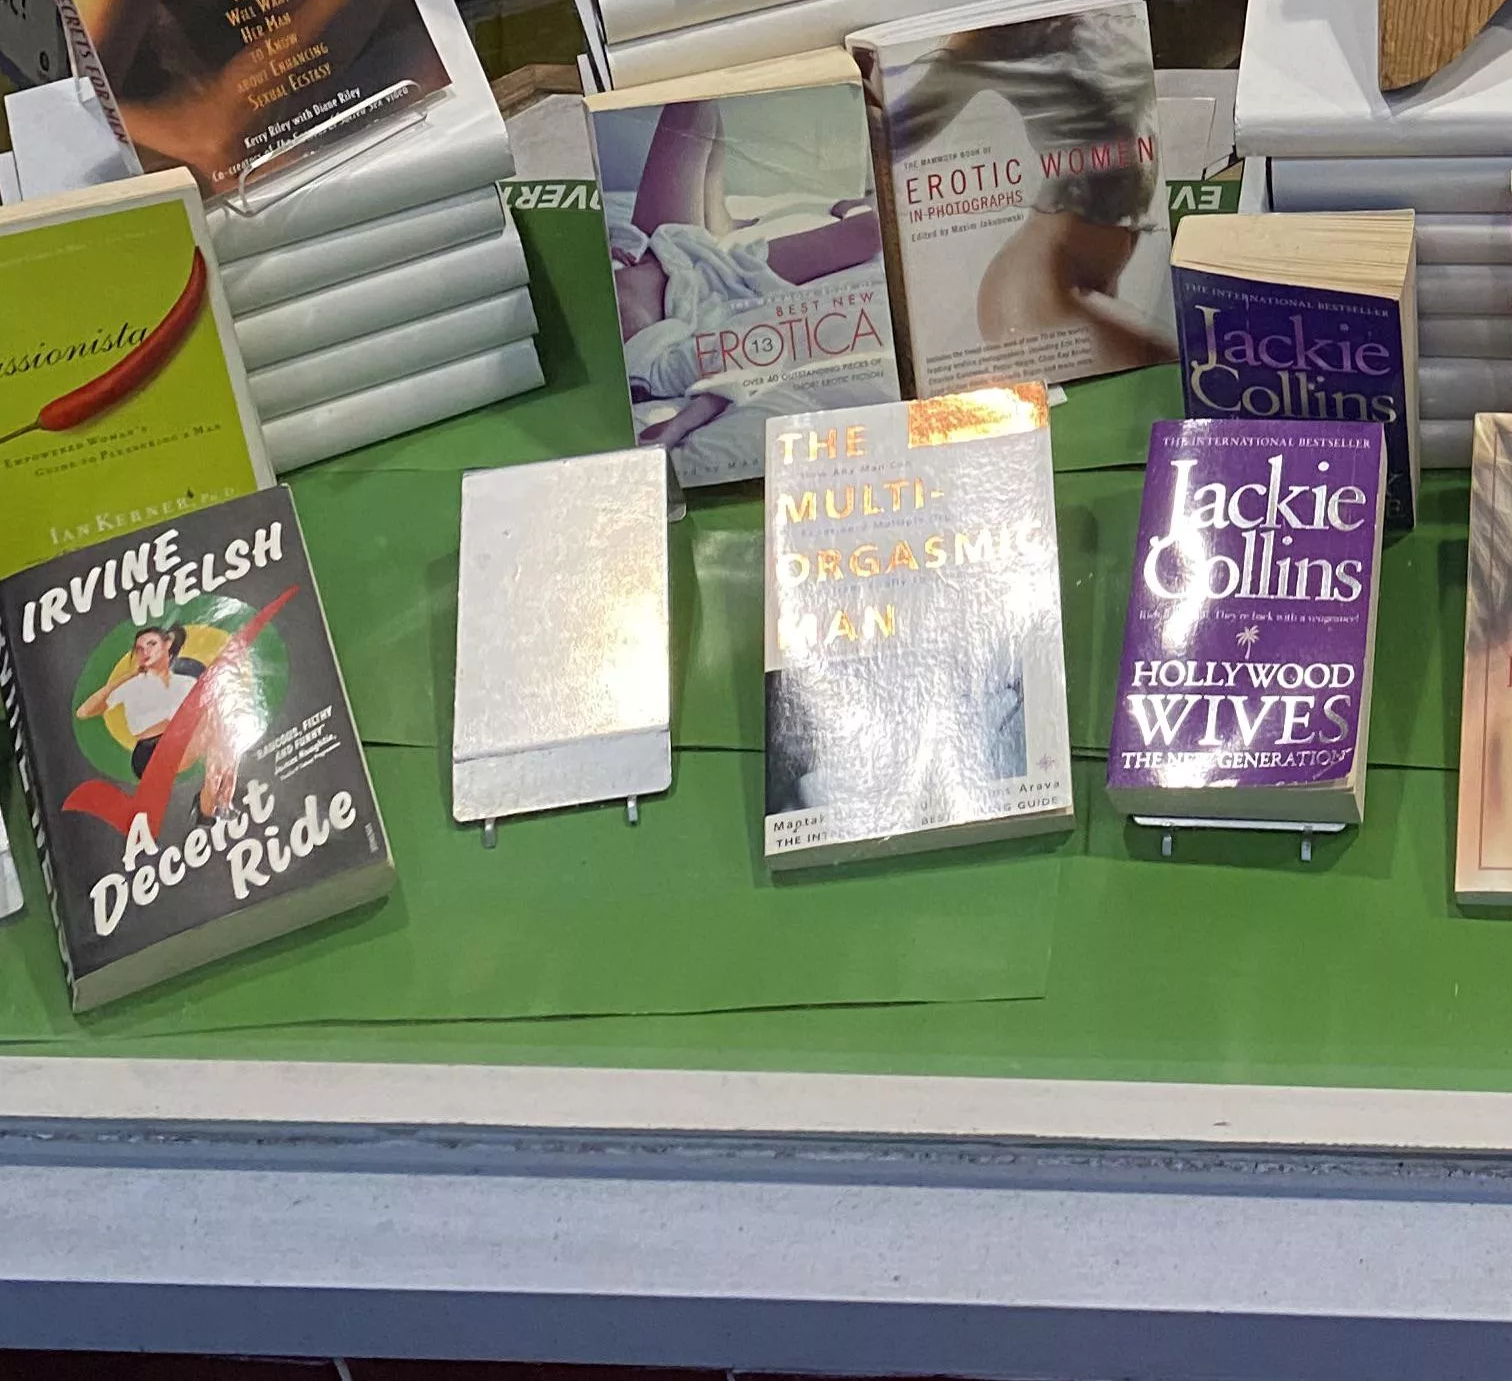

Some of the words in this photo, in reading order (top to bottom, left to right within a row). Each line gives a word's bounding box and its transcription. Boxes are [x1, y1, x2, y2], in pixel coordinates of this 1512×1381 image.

[244, 130, 268, 149] Kerry
[268, 119, 291, 137] Riley
[906, 158, 1022, 205] EROTIC
[1040, 136, 1155, 180] WOMEN
[909, 210, 922, 223] IN
[928, 190, 1023, 219] PHOTOGRAPHS
[912, 230, 937, 242] Edited
[776, 301, 819, 317] BEST
[833, 292, 874, 307] NEW
[1212, 287, 1312, 309] INTERNATIONAL
[696, 308, 883, 378] EROTICA
[752, 338, 773, 354] 13
[1191, 305, 1391, 376] Jackie
[780, 367, 841, 382] OUTSTANDING
[1190, 364, 1397, 424] Collins
[776, 425, 869, 465] THE
[1299, 437, 1371, 448] BESTSELLER
[777, 479, 944, 525] MULTI-
[1150, 454, 1367, 546] Jackie
[50, 525, 89, 545] IAN
[776, 520, 1041, 589] ORGASMIC
[21, 529, 180, 643] IRVINE
[128, 521, 283, 626] WELSH
[1143, 530, 1362, 601] Collins
[1132, 660, 1354, 689] HOLLYWOOD
[1127, 694, 1351, 747] WIVES
[1122, 752, 1162, 768] THE
[1219, 748, 1352, 768] GENERATION
[1017, 796, 1059, 811] GUIDE
[89, 778, 275, 937] Decent
[123, 812, 159, 872] A
[226, 790, 357, 900] Ride
